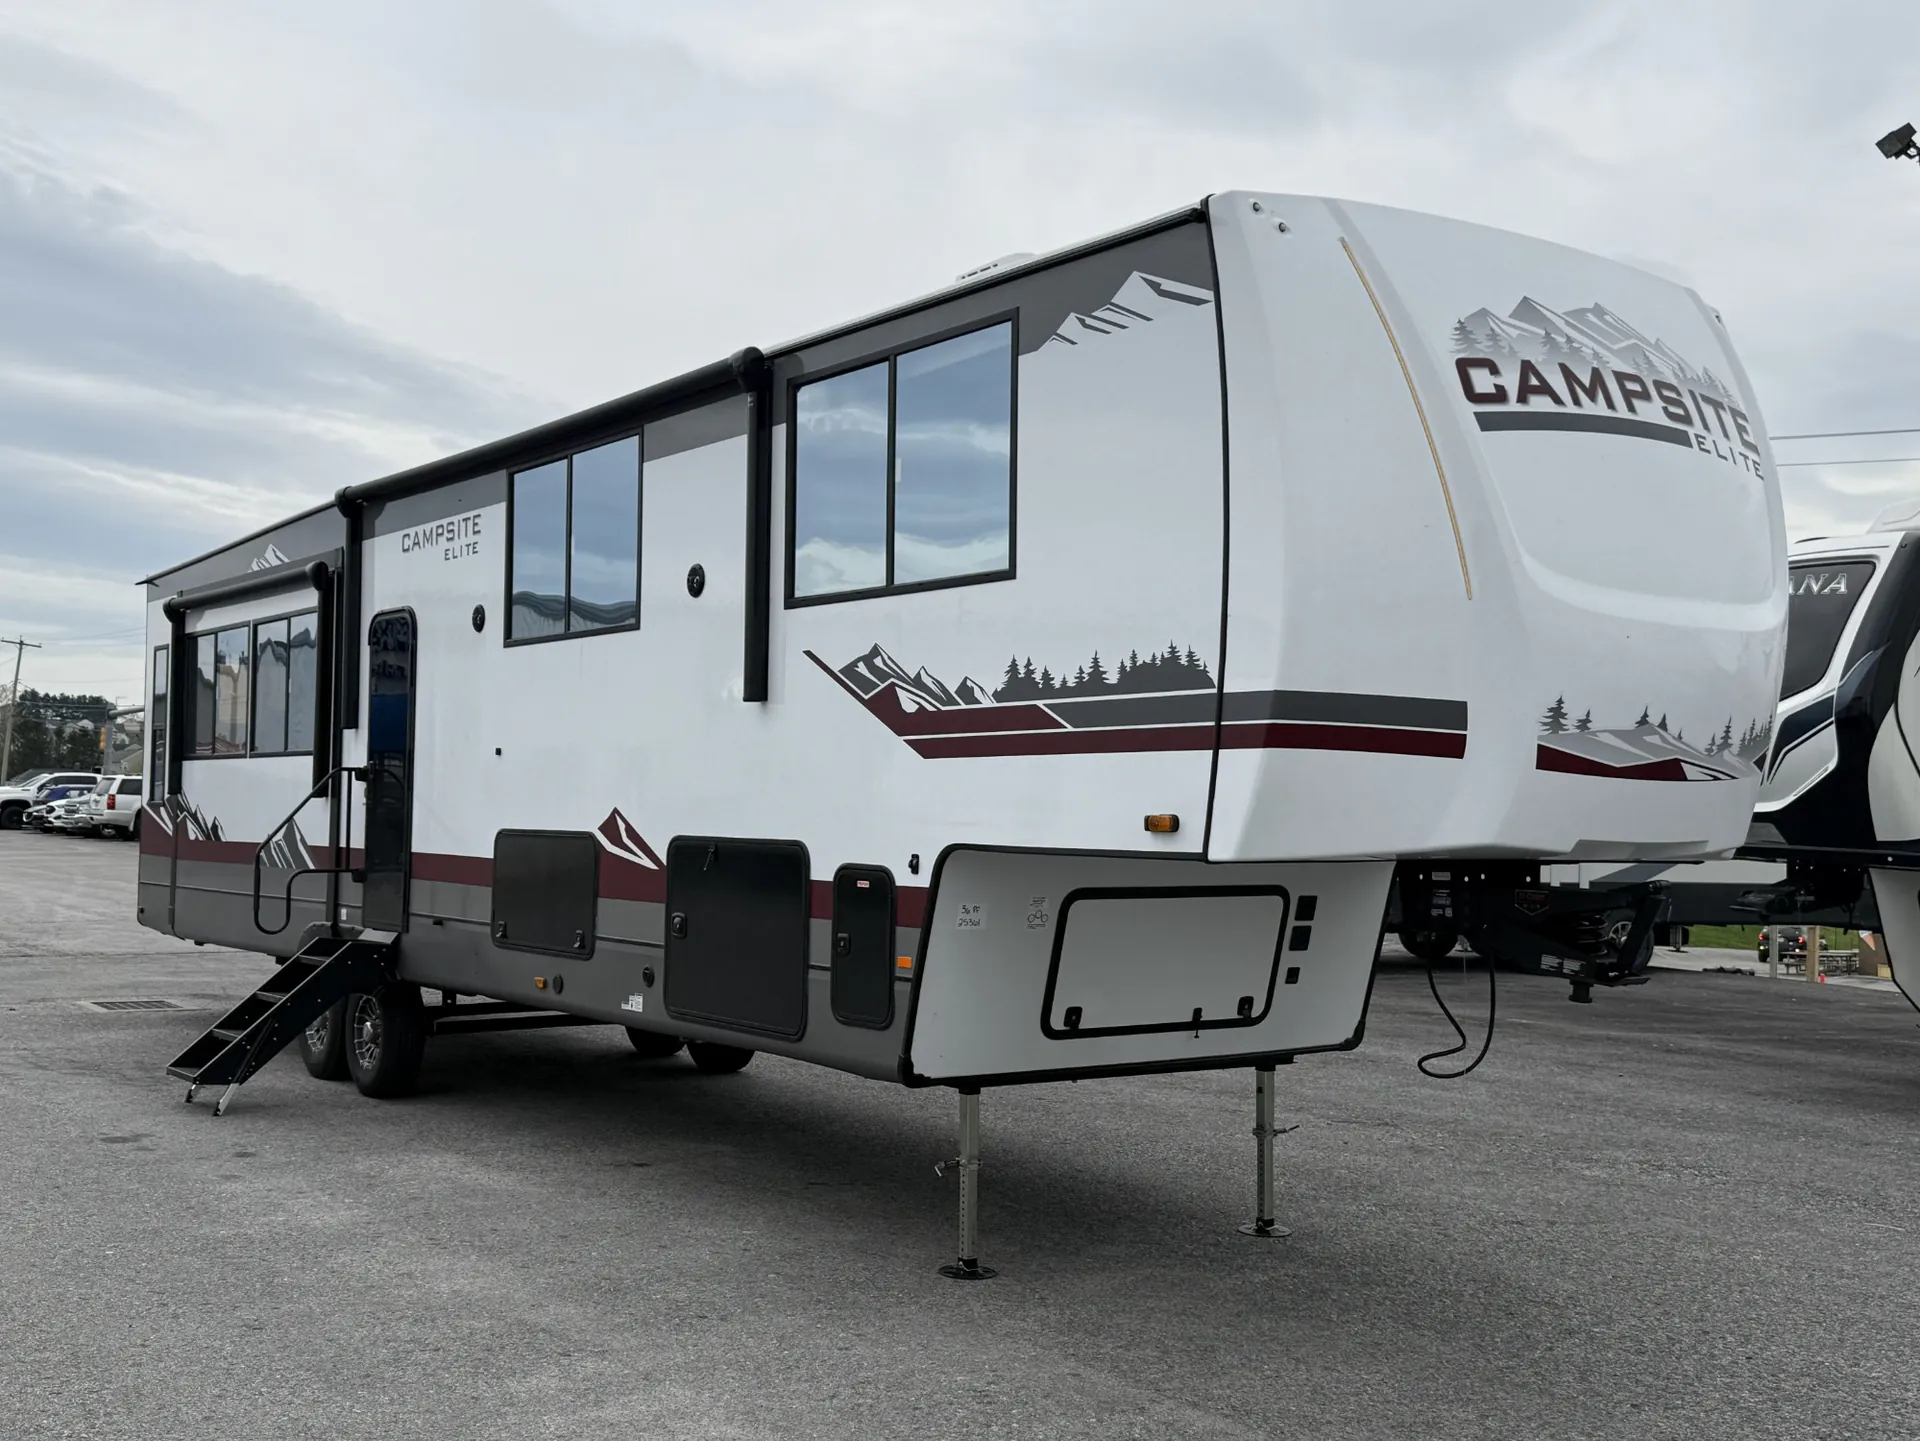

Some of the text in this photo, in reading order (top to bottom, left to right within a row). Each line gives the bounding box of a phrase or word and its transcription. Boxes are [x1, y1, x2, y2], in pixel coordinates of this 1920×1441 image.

[1455, 357, 1761, 457] CAMPSITE
[1692, 433, 1765, 481] ELITE
[401, 513, 482, 553] CAMPSITE
[444, 541, 479, 561] ELITE
